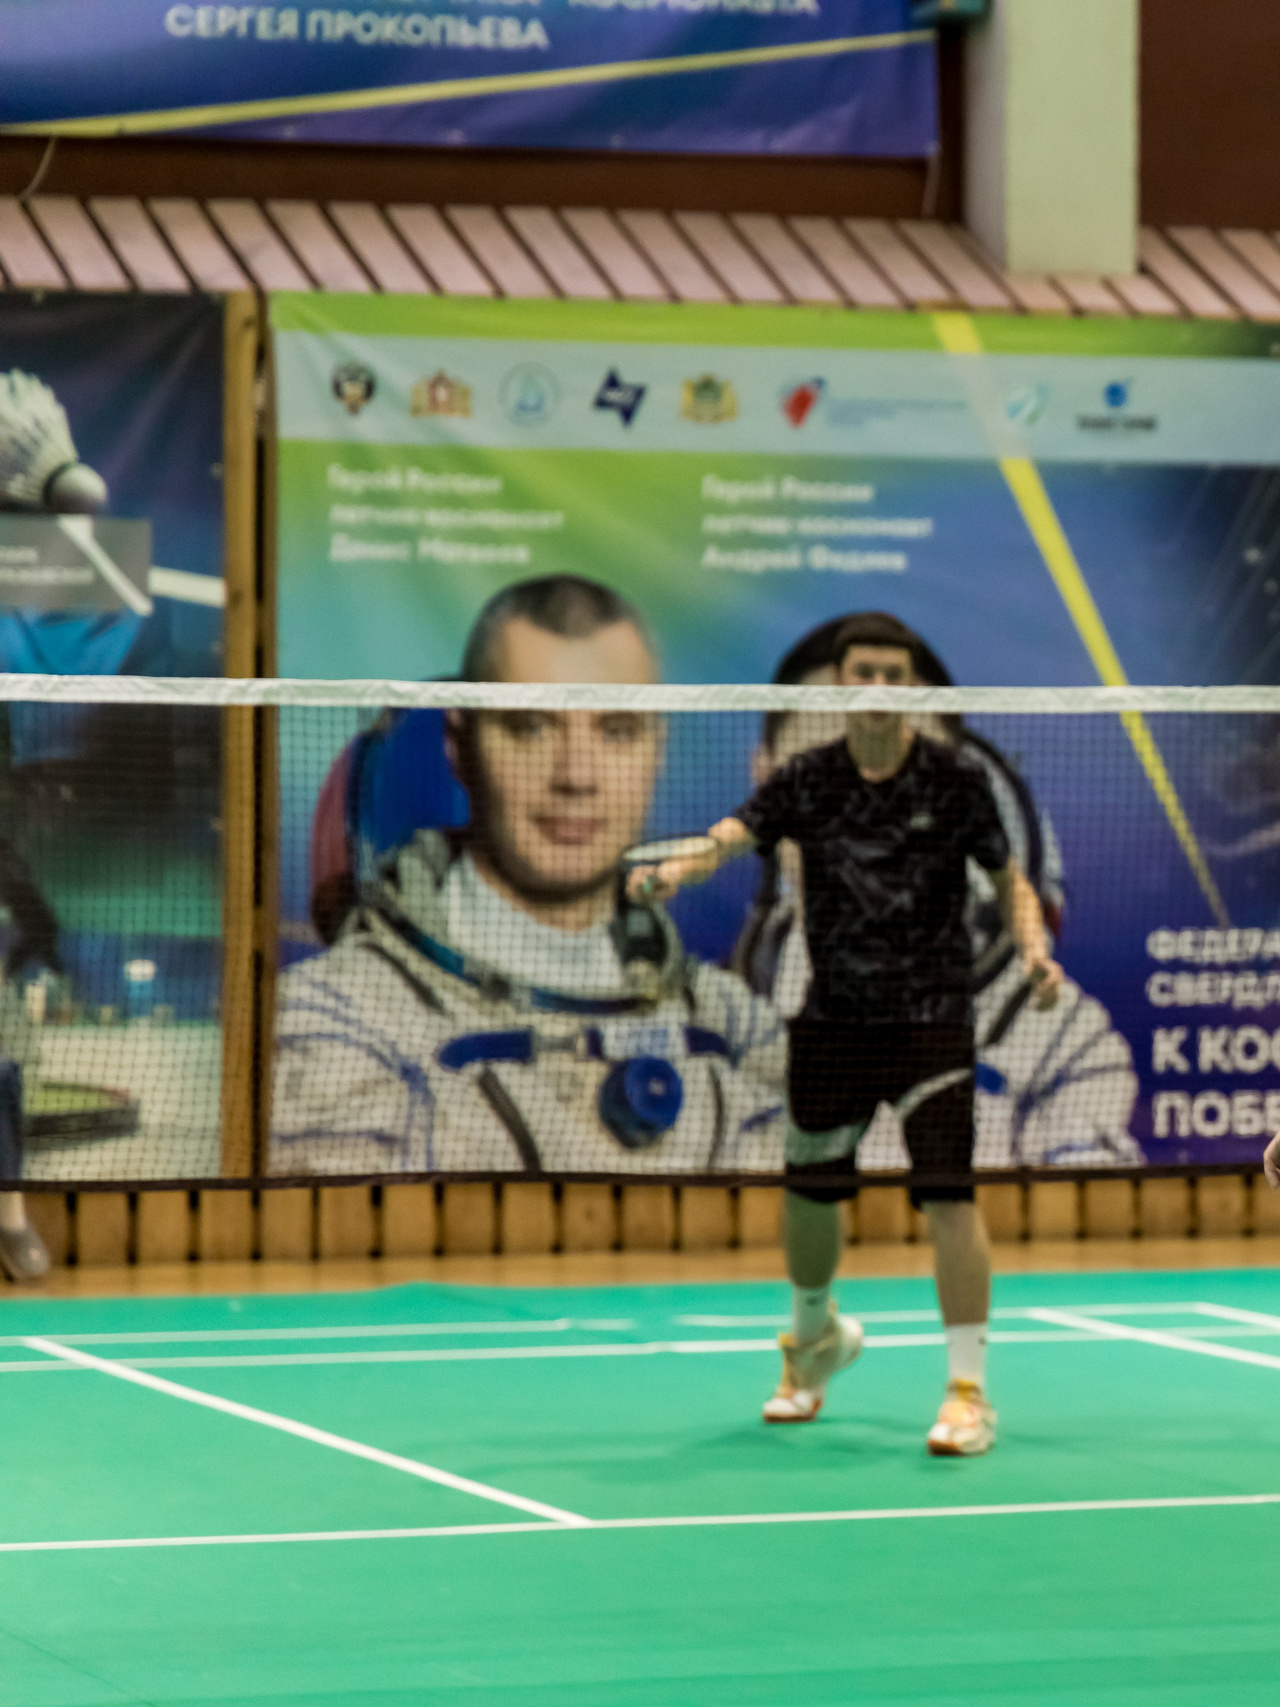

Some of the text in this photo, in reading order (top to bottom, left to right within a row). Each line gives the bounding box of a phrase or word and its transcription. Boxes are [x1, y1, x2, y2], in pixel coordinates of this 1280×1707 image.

[164, 4, 549, 48] СЕРГЕЯ ПРОКОПЬЕВА
[1152, 1025, 1190, 1073] К
